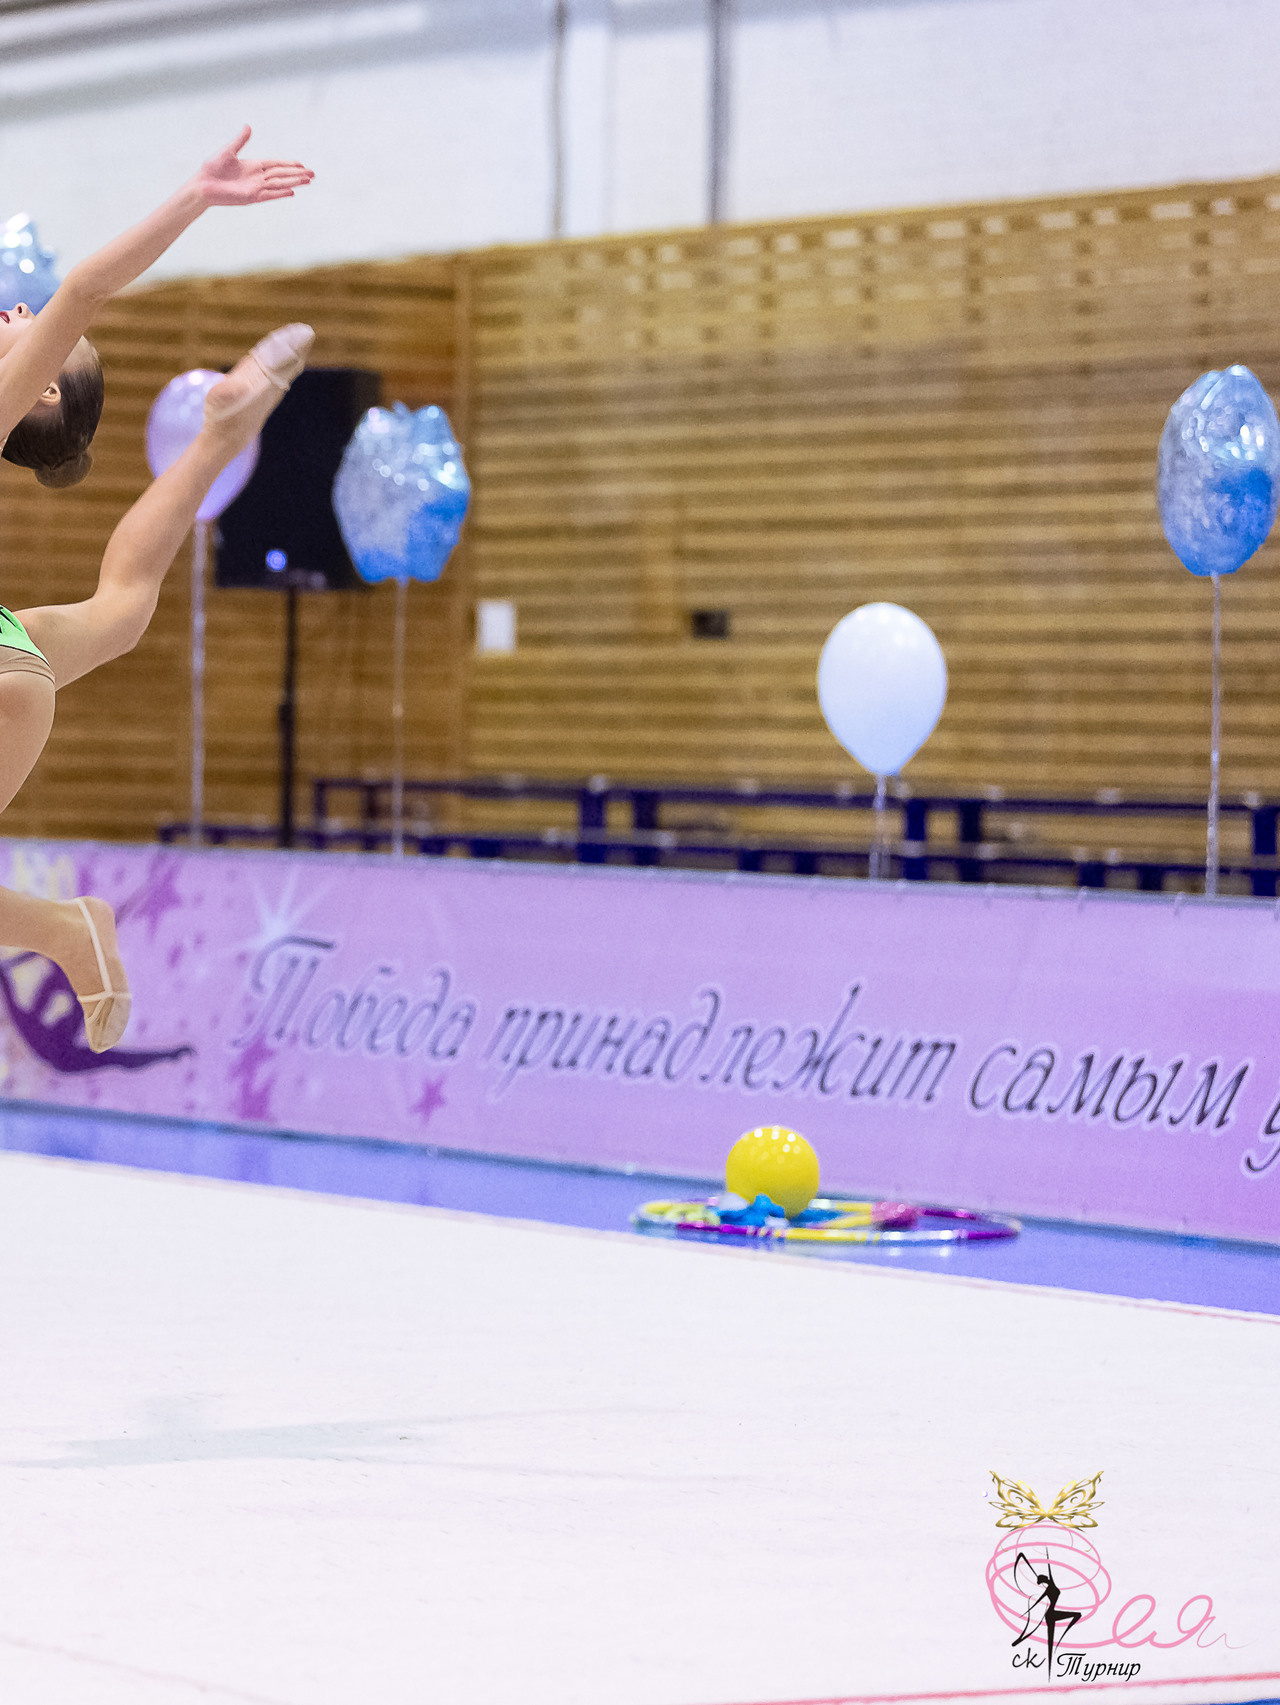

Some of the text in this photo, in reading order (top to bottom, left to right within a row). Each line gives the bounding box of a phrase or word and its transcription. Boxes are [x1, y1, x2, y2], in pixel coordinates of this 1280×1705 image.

[230, 935, 1251, 1130] Победа принадлежит самым
